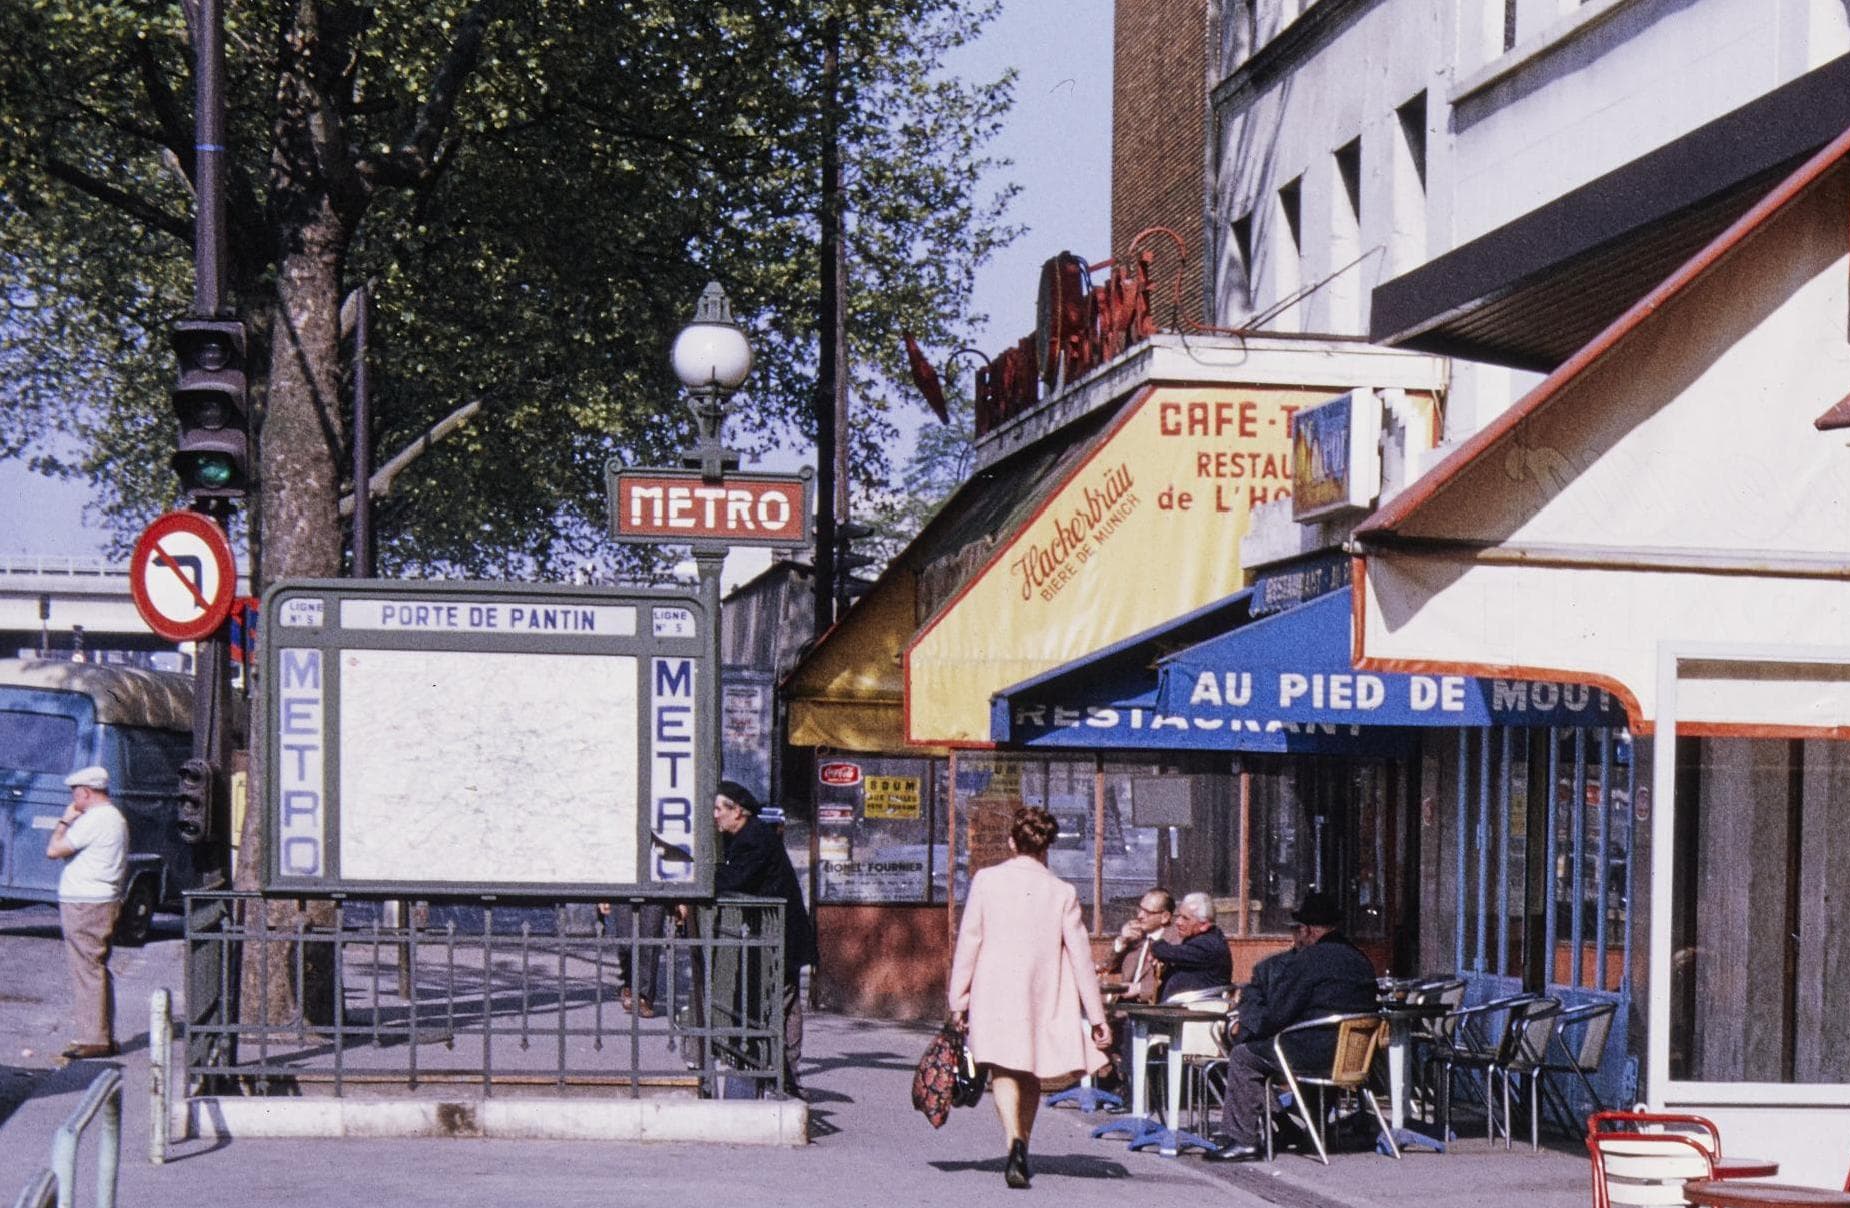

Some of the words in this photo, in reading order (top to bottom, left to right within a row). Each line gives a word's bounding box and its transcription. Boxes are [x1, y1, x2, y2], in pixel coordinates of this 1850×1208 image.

[1197, 451, 1293, 480] RESTAU
[631, 486, 791, 531] METRO
[1157, 484, 1194, 510] de
[1010, 463, 1134, 601] Hackerbräu
[1075, 543, 1095, 564] DE
[1093, 493, 1142, 546] MUNICH
[381, 605, 459, 628] PORTE
[469, 607, 498, 628] DE
[509, 608, 596, 632] PANTIN
[654, 611, 688, 621] LIGNE
[1189, 671, 1252, 707] AU
[1279, 673, 1385, 710] PIED
[1409, 676, 1466, 712] DE
[282, 650, 321, 876] METRO
[656, 660, 692, 880] METRO
